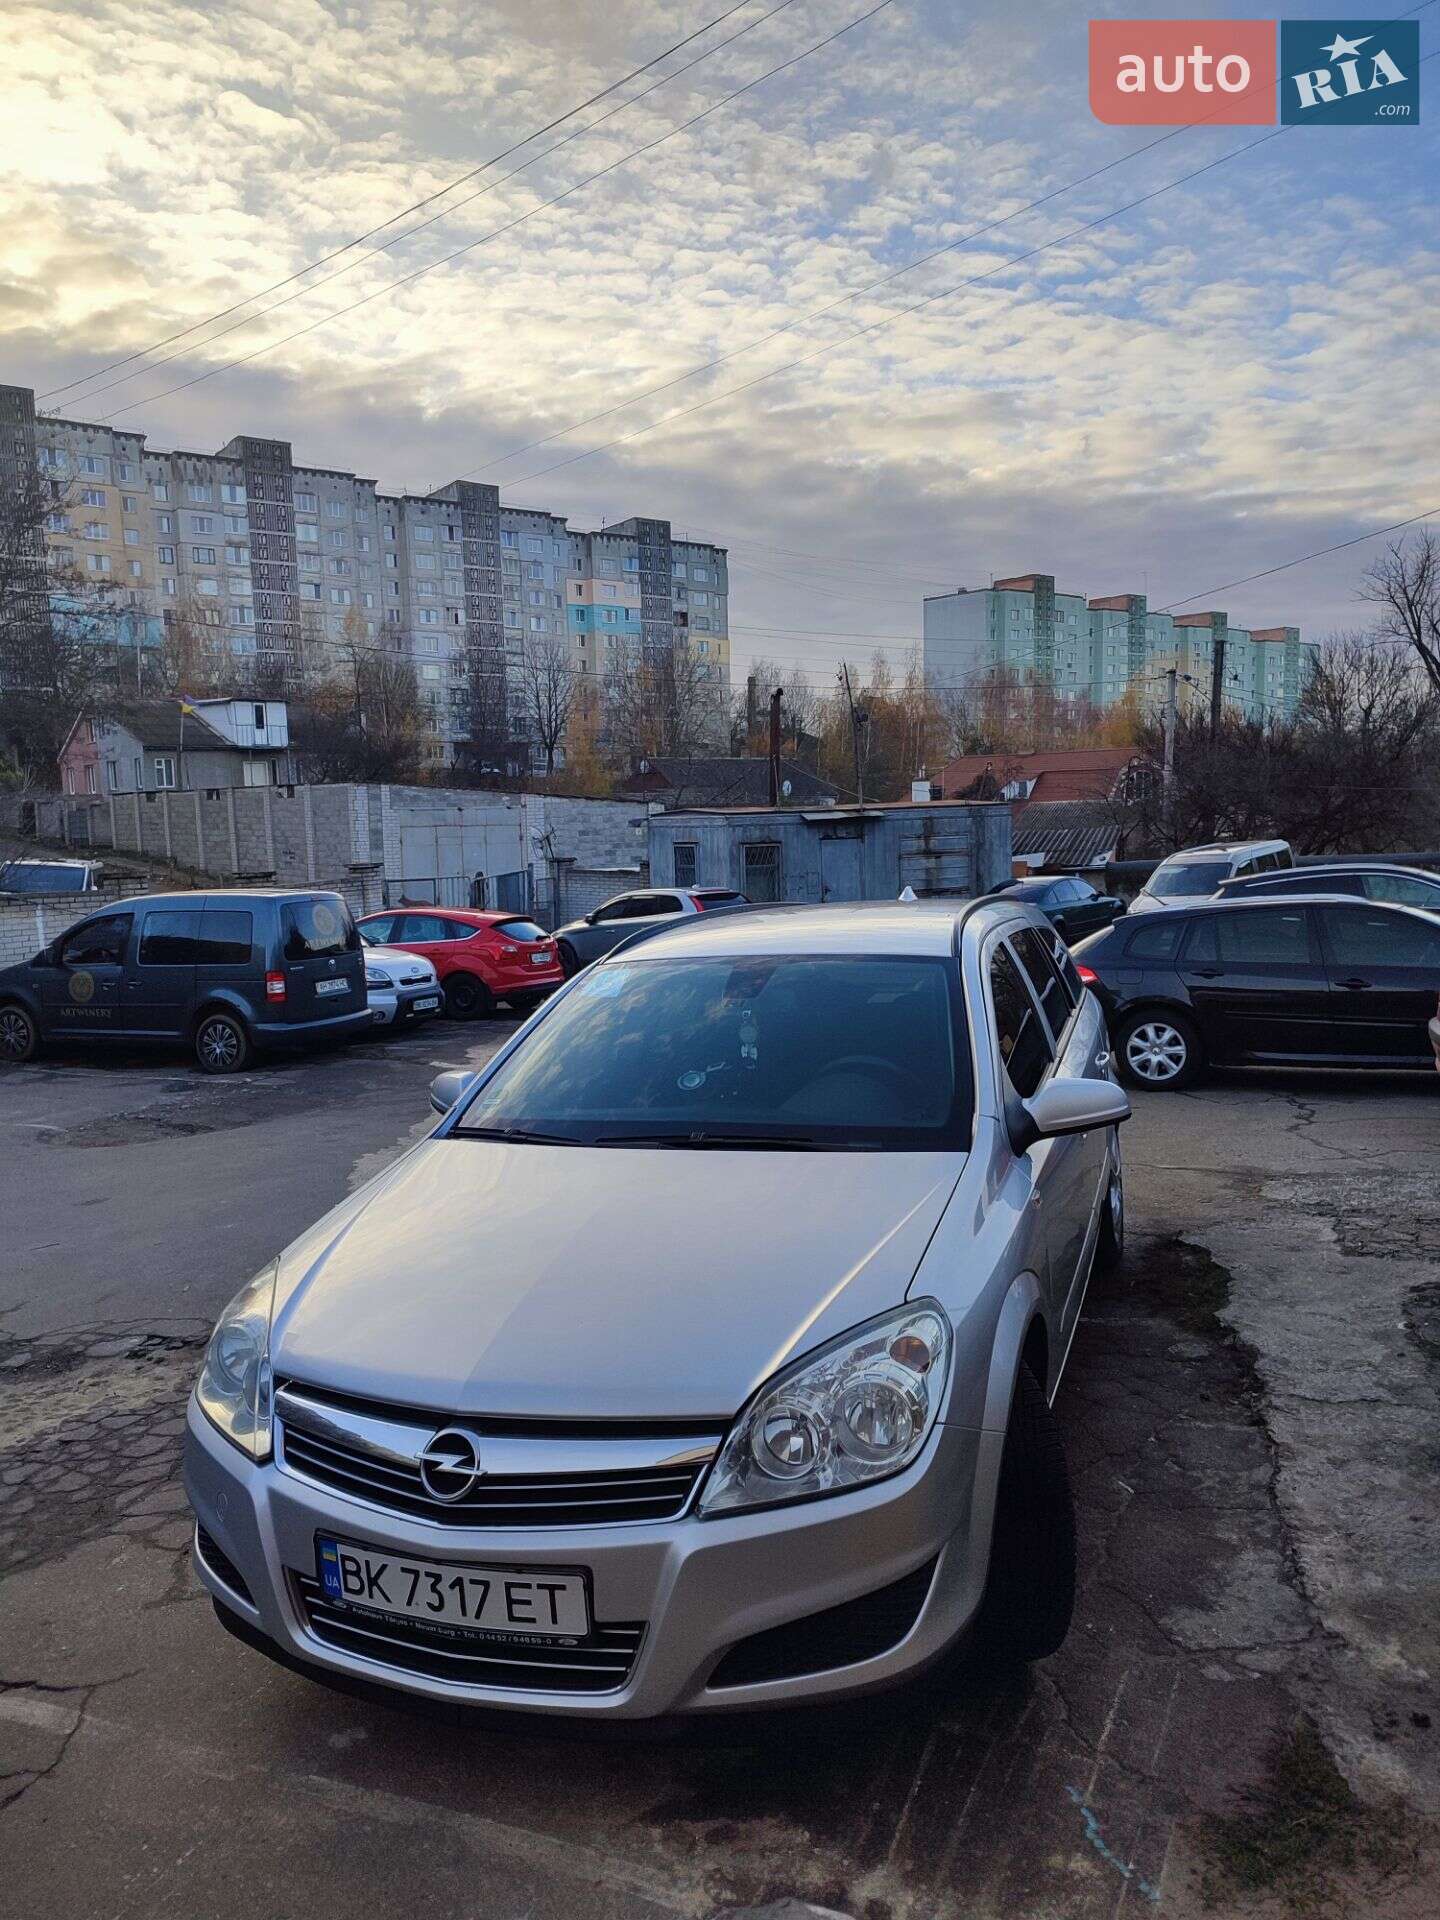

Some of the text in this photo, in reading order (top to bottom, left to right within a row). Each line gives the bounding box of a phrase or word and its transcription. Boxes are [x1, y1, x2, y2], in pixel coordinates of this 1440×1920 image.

[325, 1574, 340, 1589] UA
[340, 1554, 567, 1624] BK 7317 ET
